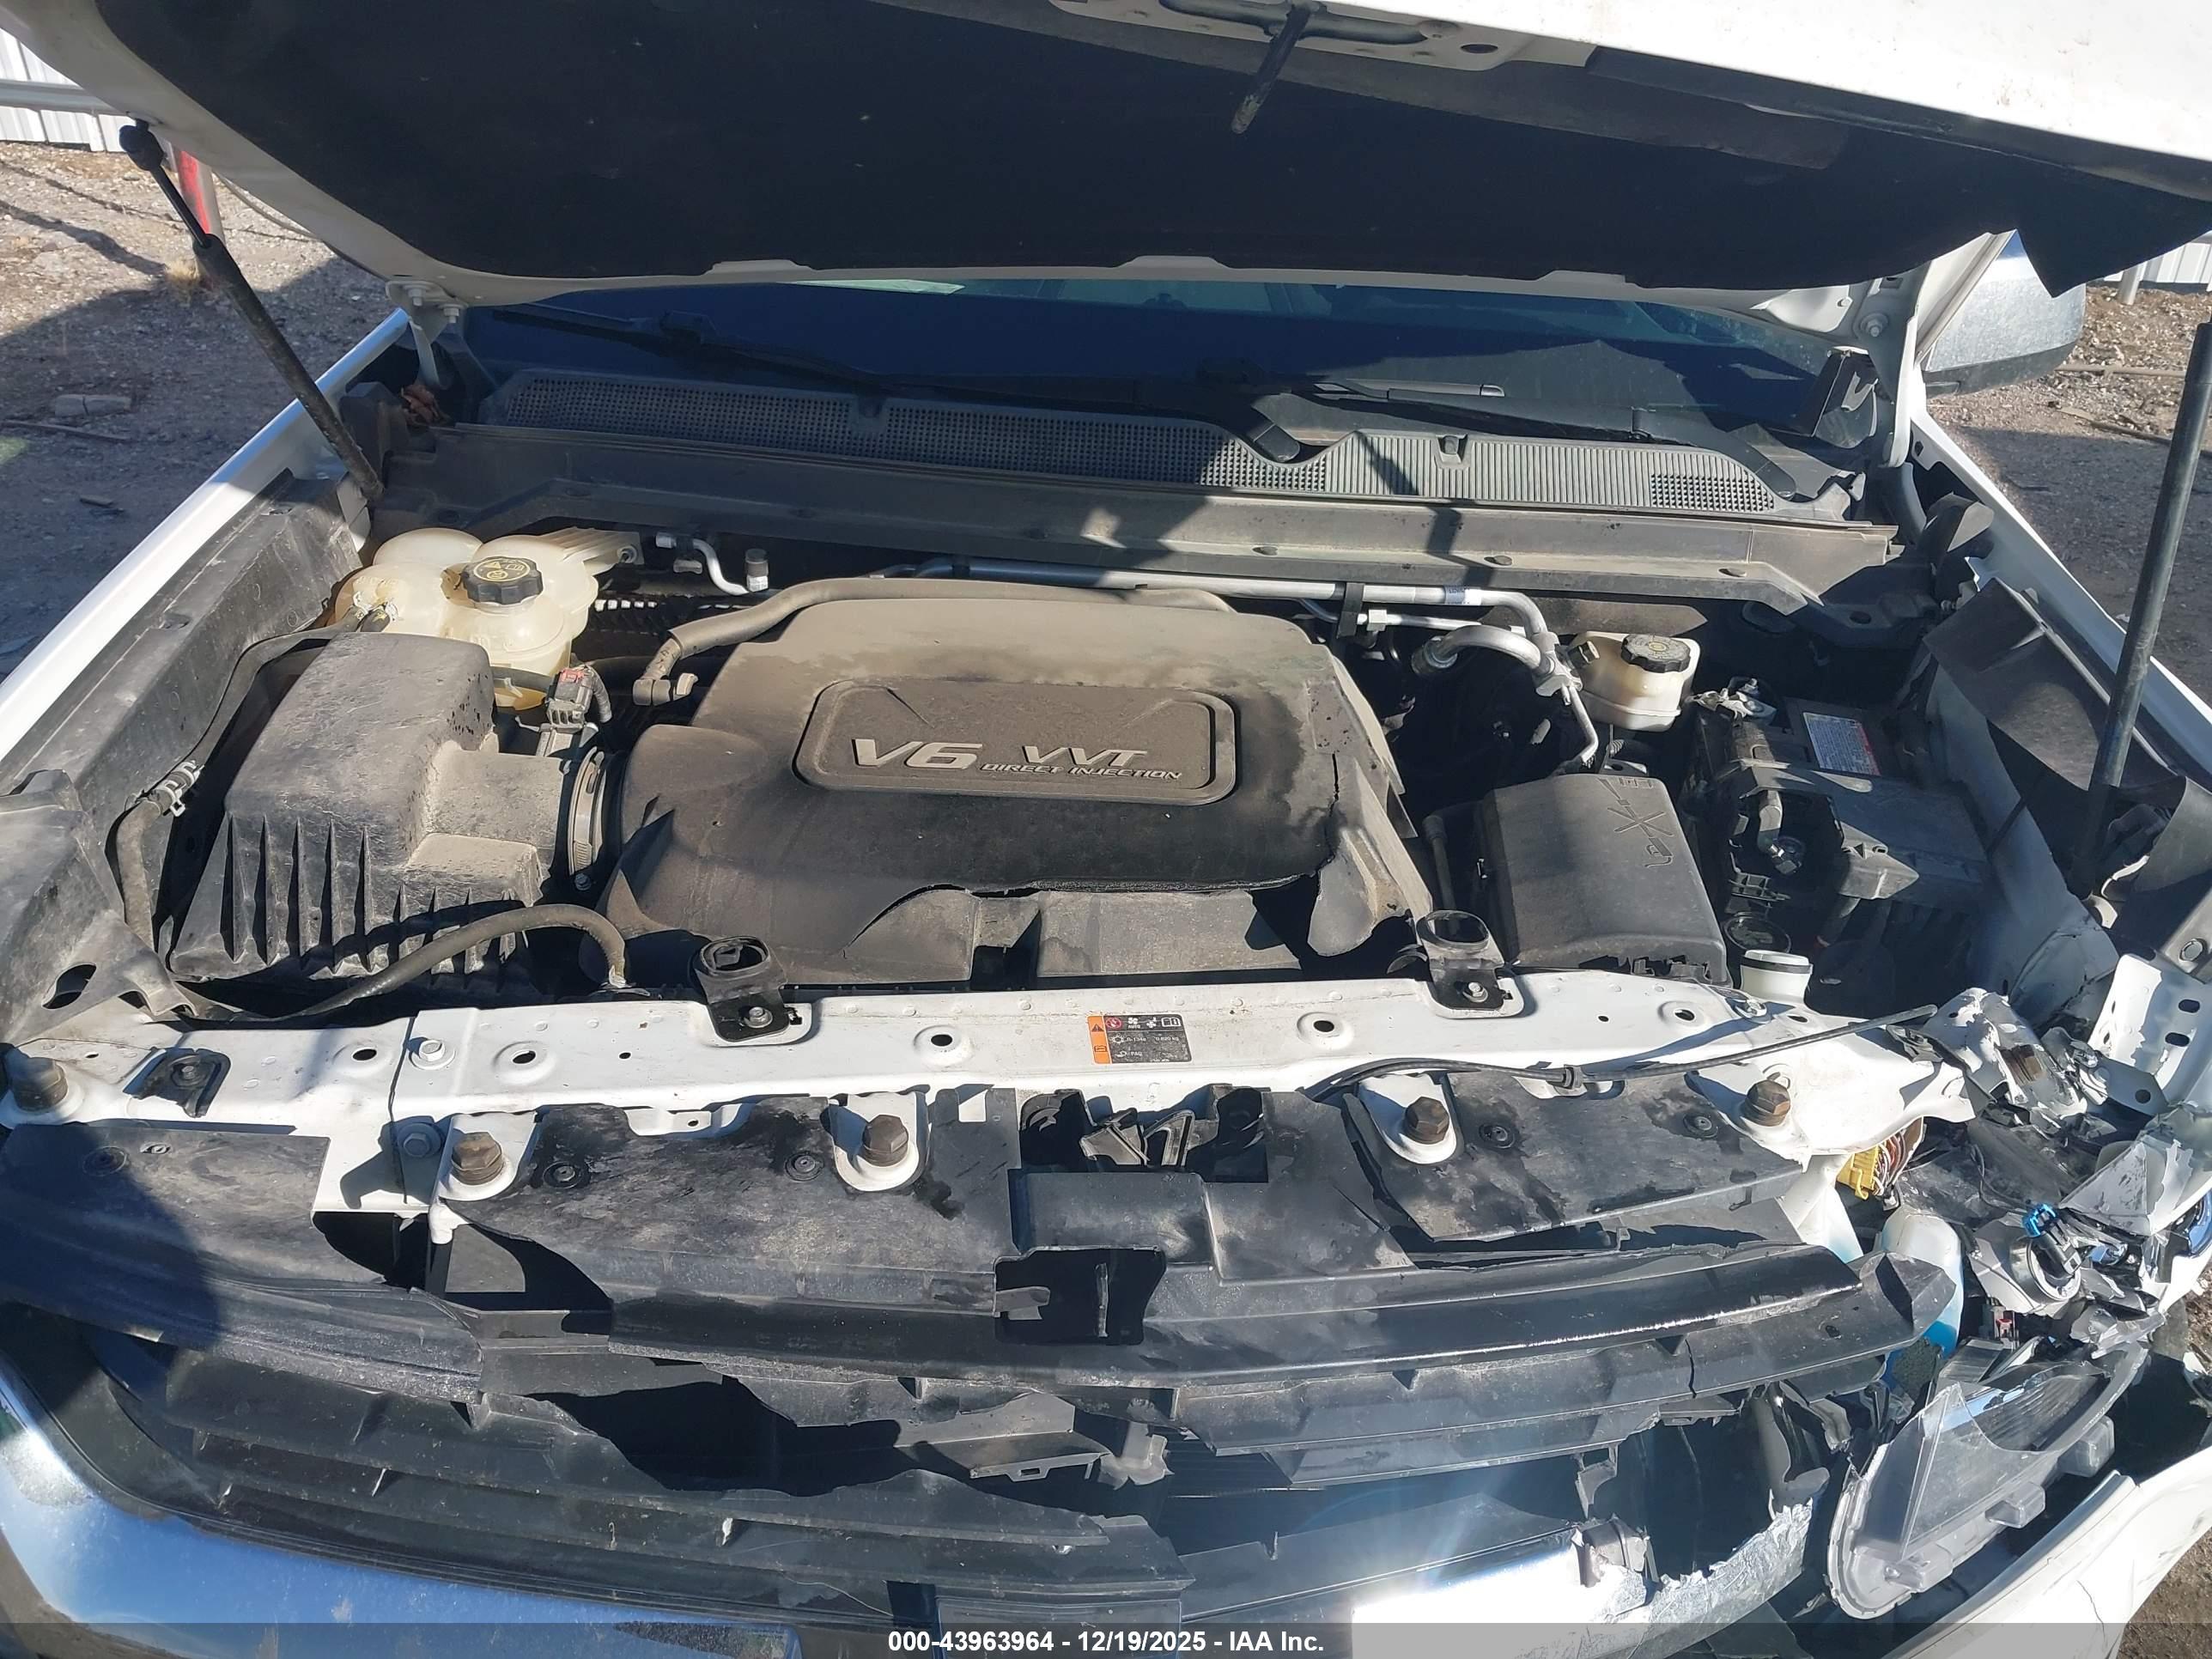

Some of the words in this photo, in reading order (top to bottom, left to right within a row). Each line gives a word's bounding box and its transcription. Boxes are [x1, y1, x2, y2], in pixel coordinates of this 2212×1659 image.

[851, 738, 983, 770] V6
[1022, 745, 1148, 767] VVT
[980, 763, 1064, 774] DIRECT
[1068, 766, 1182, 781] INJECTION
